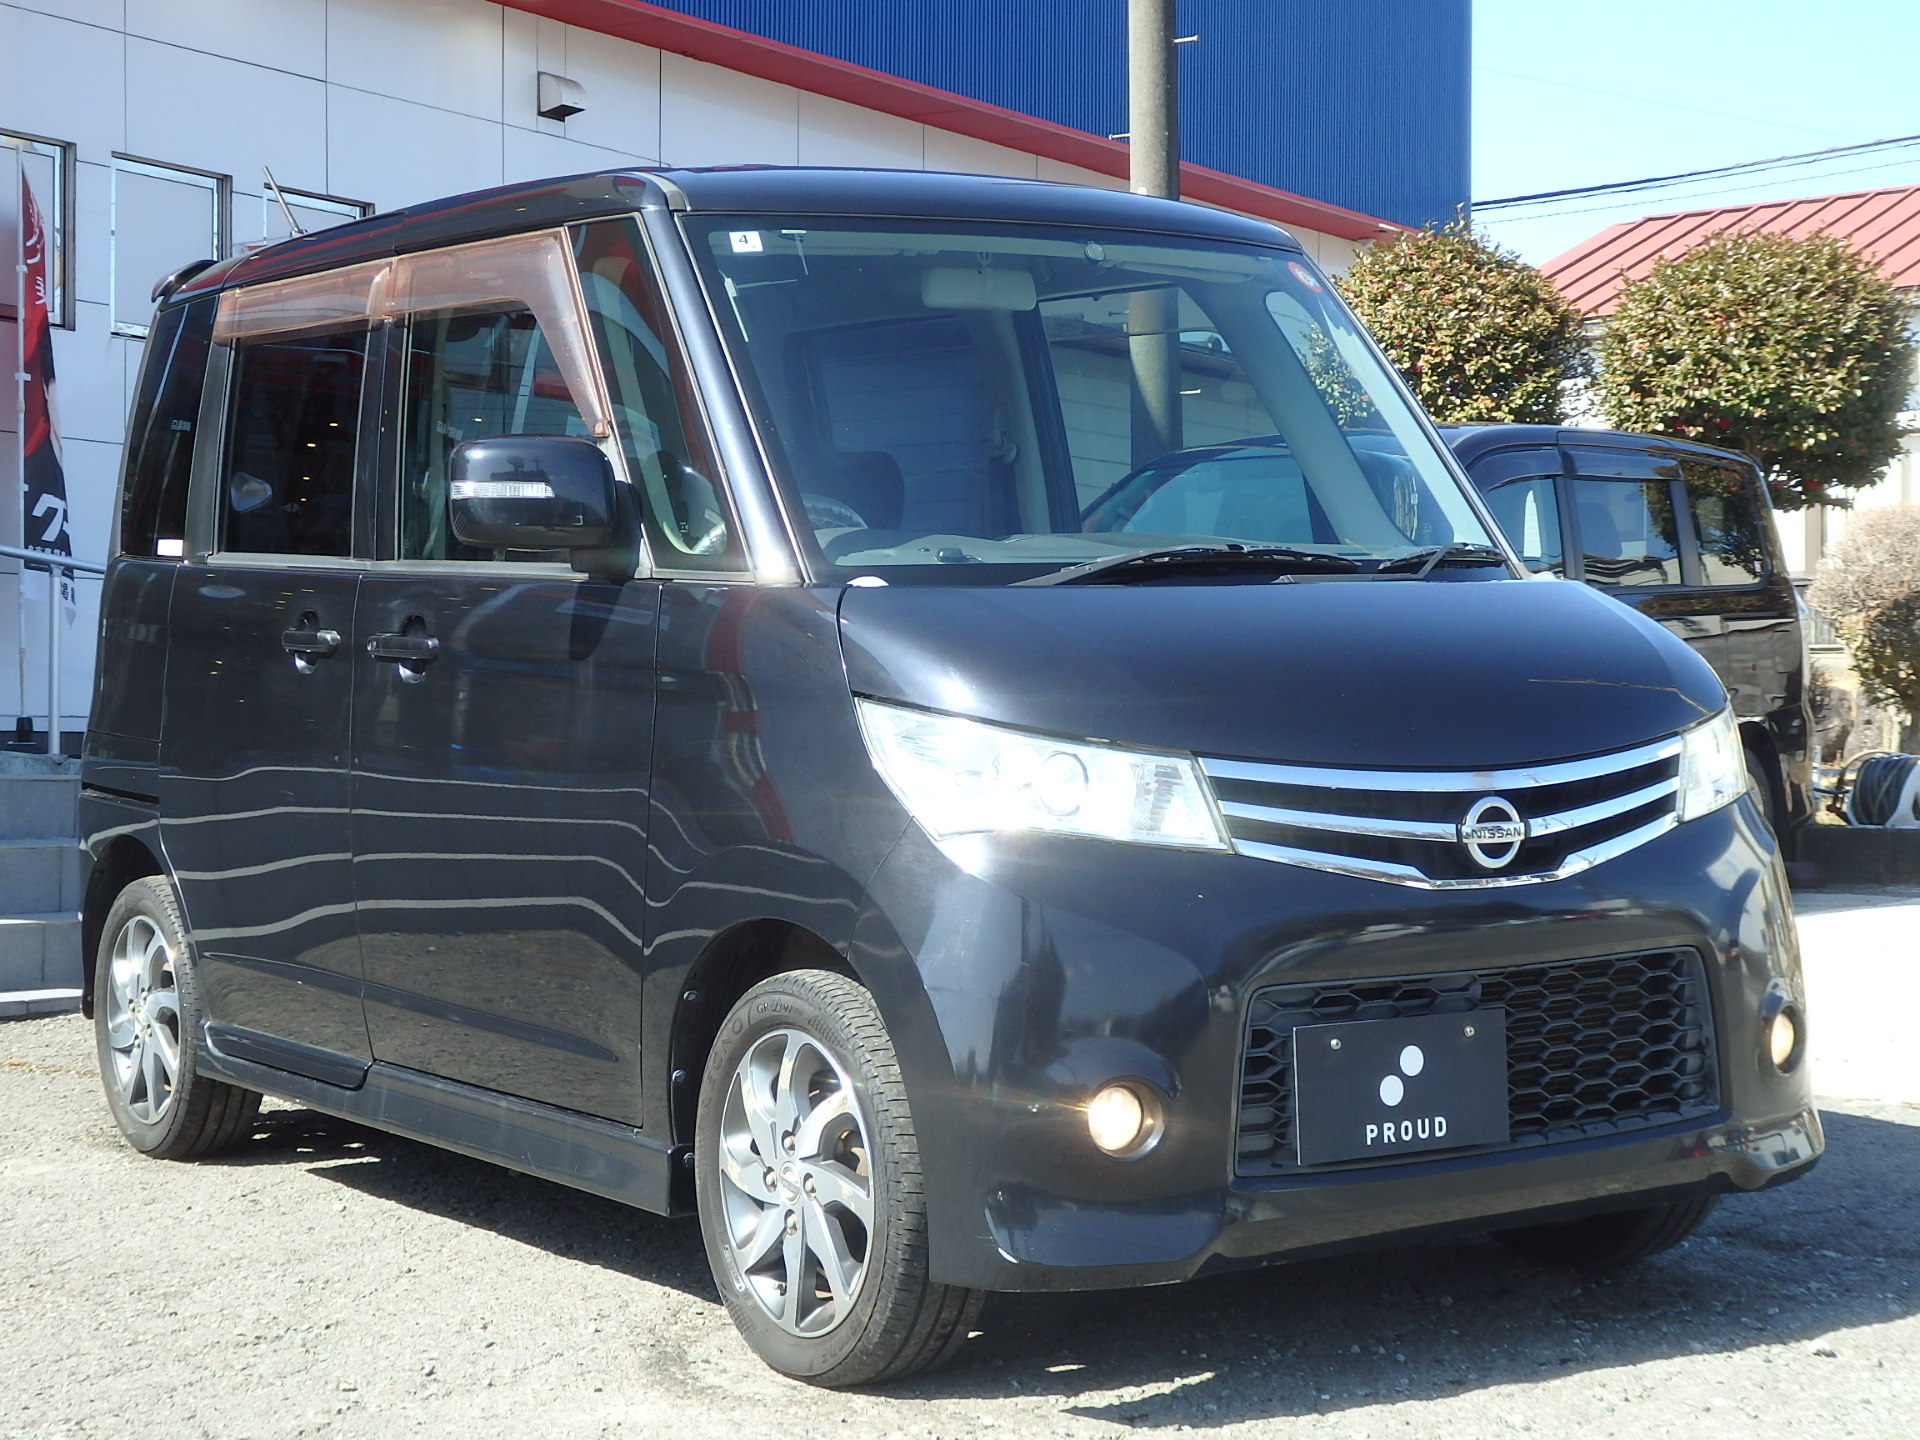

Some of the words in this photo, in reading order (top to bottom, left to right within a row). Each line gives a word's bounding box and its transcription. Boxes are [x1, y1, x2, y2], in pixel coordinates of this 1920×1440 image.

[738, 234, 748, 244] 4
[1471, 826, 1521, 839] NISSAN
[1365, 1116, 1447, 1146] PROUD
